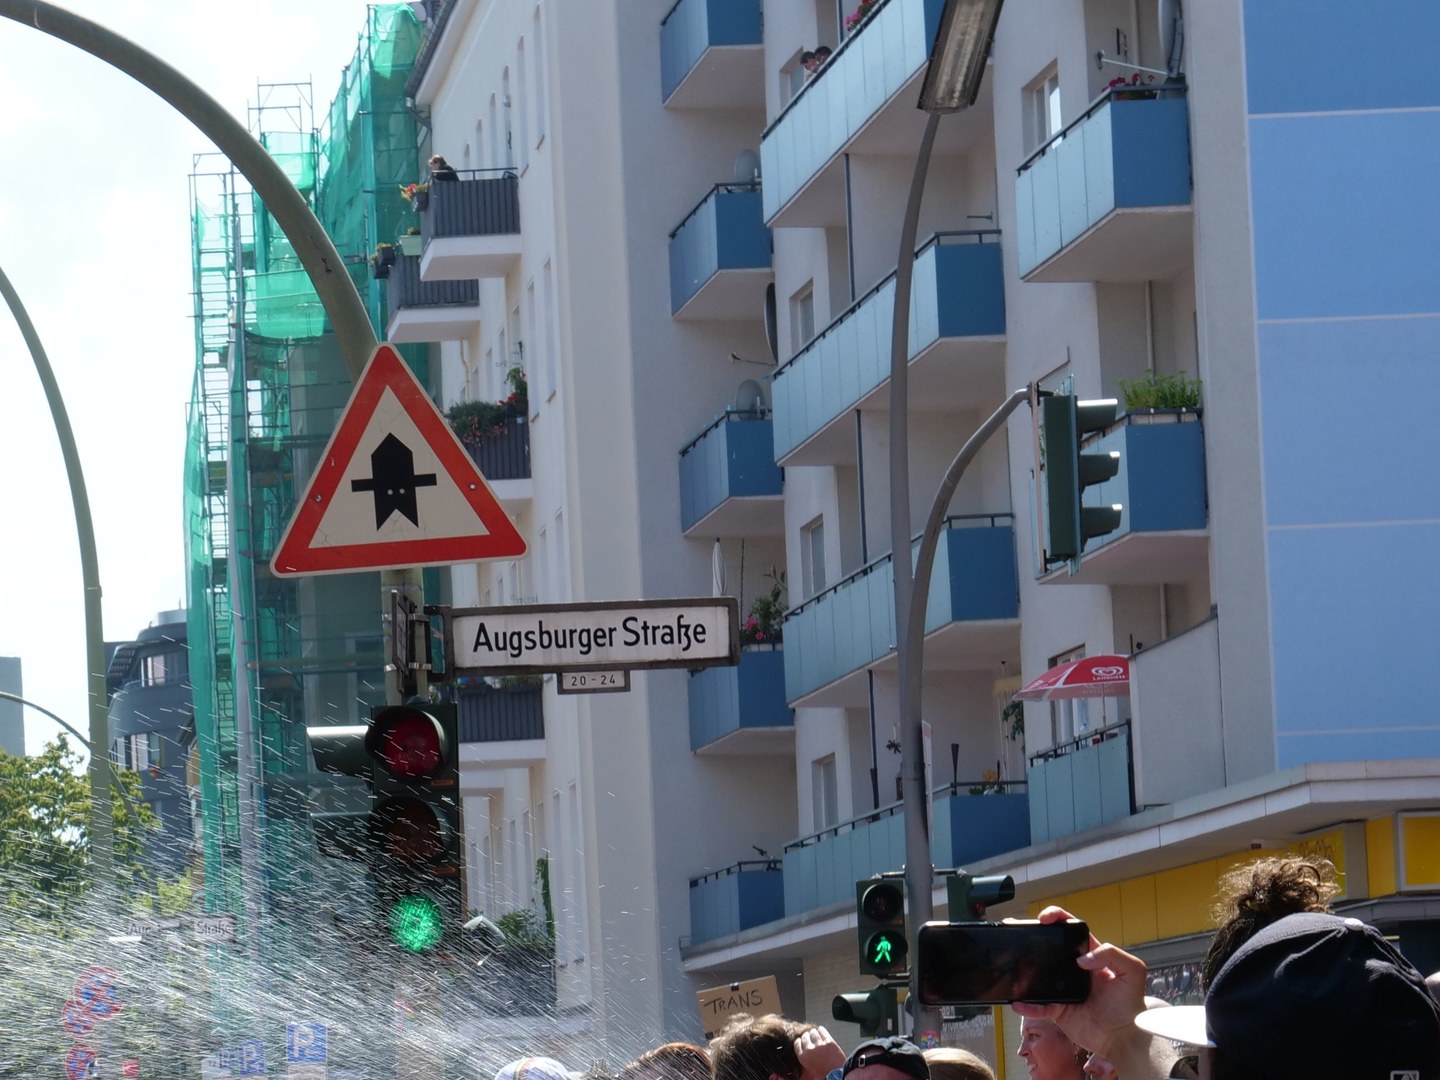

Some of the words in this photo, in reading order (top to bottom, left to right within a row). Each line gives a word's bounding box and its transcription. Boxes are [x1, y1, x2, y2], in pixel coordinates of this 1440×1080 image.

[473, 620, 617, 658] Augsburger
[622, 614, 707, 651] Straße
[704, 989, 763, 1014] TRANS
